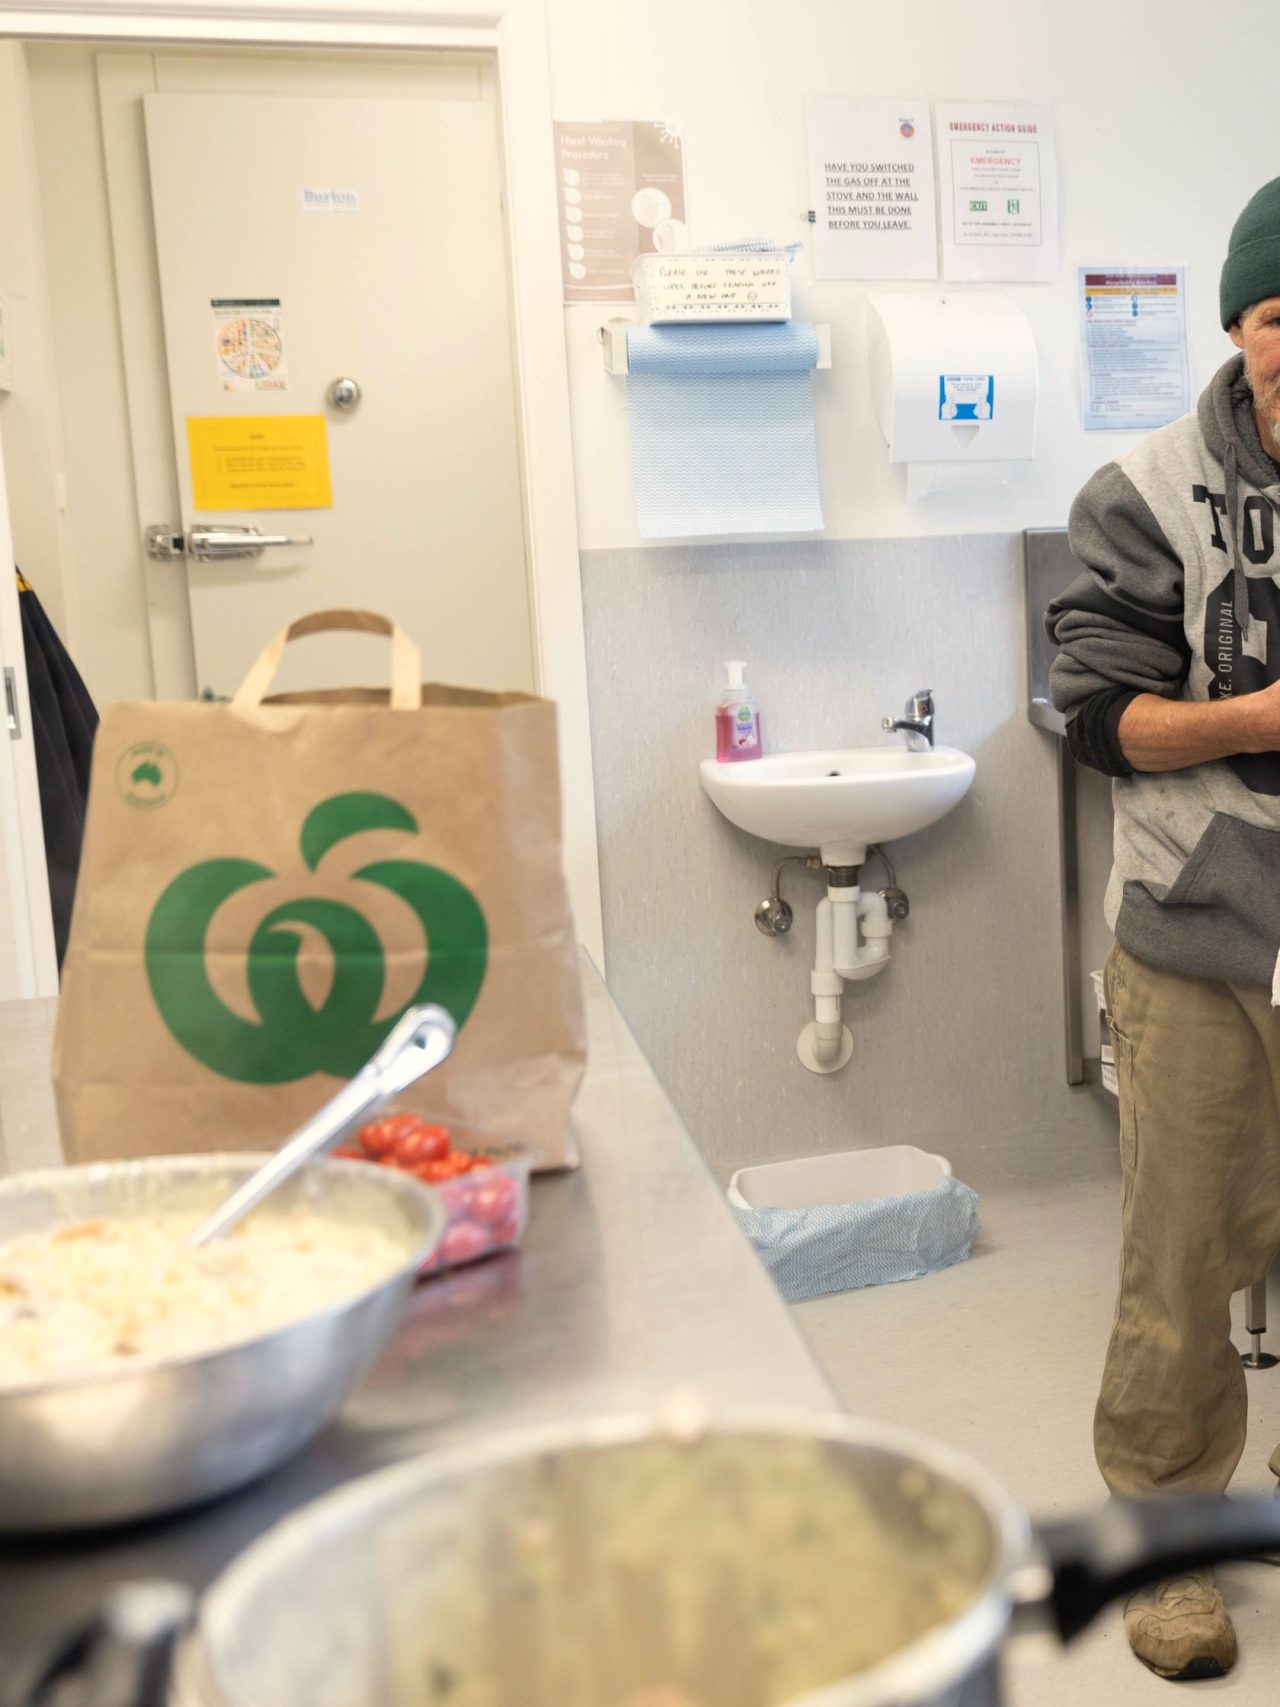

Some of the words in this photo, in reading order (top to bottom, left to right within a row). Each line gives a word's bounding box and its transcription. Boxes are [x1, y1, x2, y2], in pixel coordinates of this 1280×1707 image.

[949, 122, 989, 132] EMERGENCY
[991, 123, 1015, 133] ACTION
[1017, 124, 1037, 134] GUIDE
[560, 135, 585, 145] Hand
[588, 135, 628, 149] Washing
[560, 148, 609, 160] Procedure
[970, 156, 1021, 165] EMERGENCY
[824, 163, 847, 172] HAVE
[850, 163, 868, 172] YOU
[870, 163, 915, 173] SWITCHED
[826, 177, 841, 186] THE
[844, 177, 861, 186] GAS
[863, 177, 878, 186] OFF
[881, 178, 892, 186] AT
[895, 178, 911, 186] THE
[826, 192, 854, 201] STOVE
[856, 192, 875, 201] AND
[877, 192, 893, 201] THE
[895, 192, 919, 201] WALL
[828, 206, 846, 215] THIS
[848, 206, 872, 215] MUST
[875, 206, 886, 215] BE
[888, 206, 912, 215] DONE
[828, 220, 861, 229] BEFORE
[863, 220, 881, 229] YOU
[883, 221, 911, 230] LEAVE.
[659, 267, 686, 277] PLEASE
[1218, 601, 1233, 673] ORIGINAL
